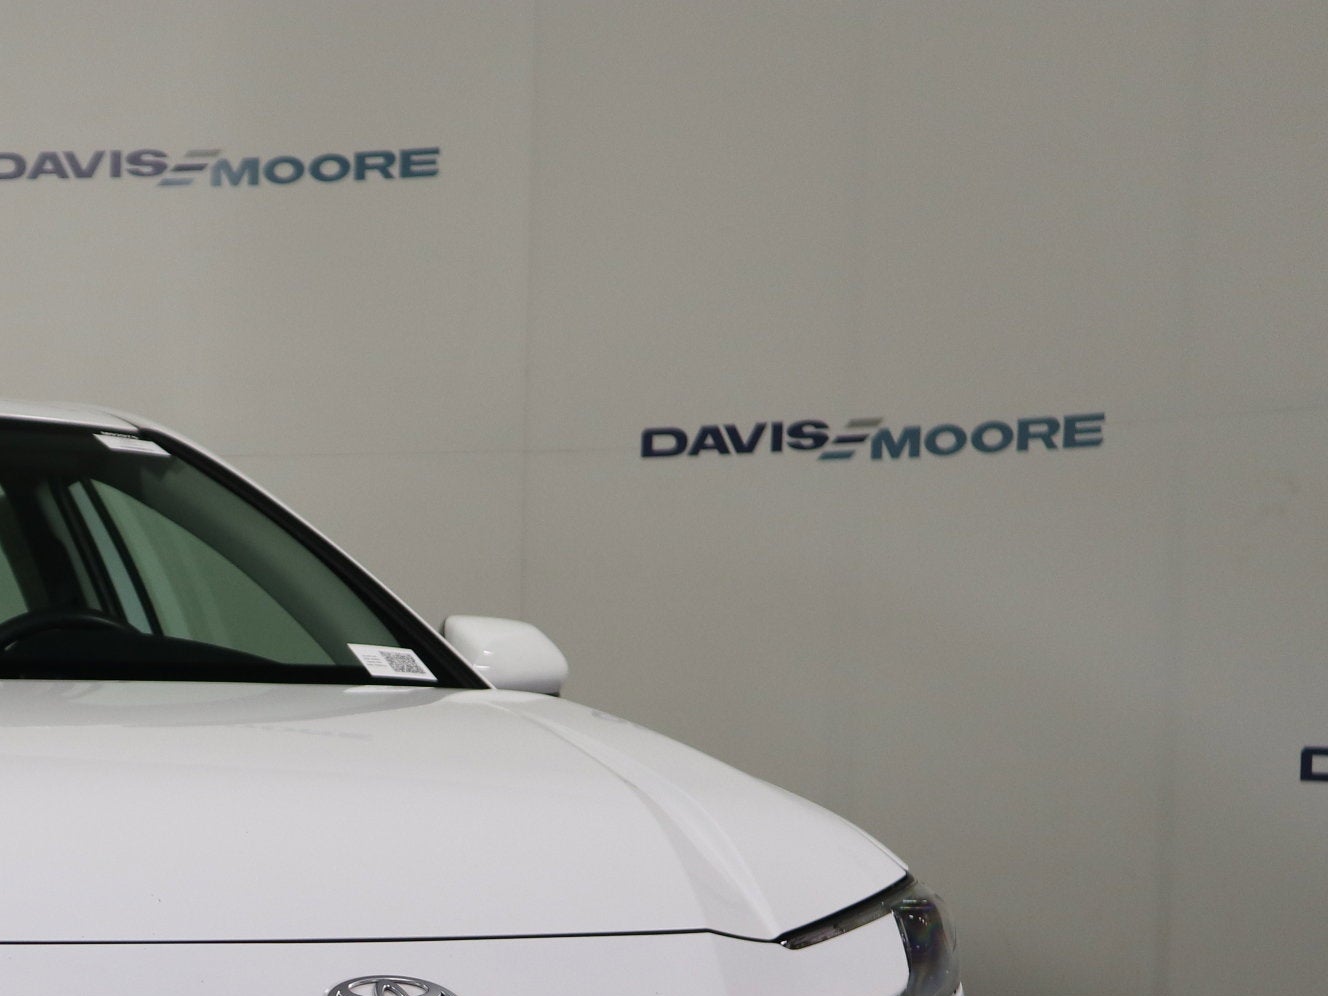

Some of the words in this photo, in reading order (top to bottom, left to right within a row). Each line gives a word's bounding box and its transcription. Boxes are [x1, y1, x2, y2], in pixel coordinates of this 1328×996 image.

[210, 147, 440, 187] MOORE
[641, 420, 829, 458] DAVIS
[871, 412, 1106, 460] MOORE
